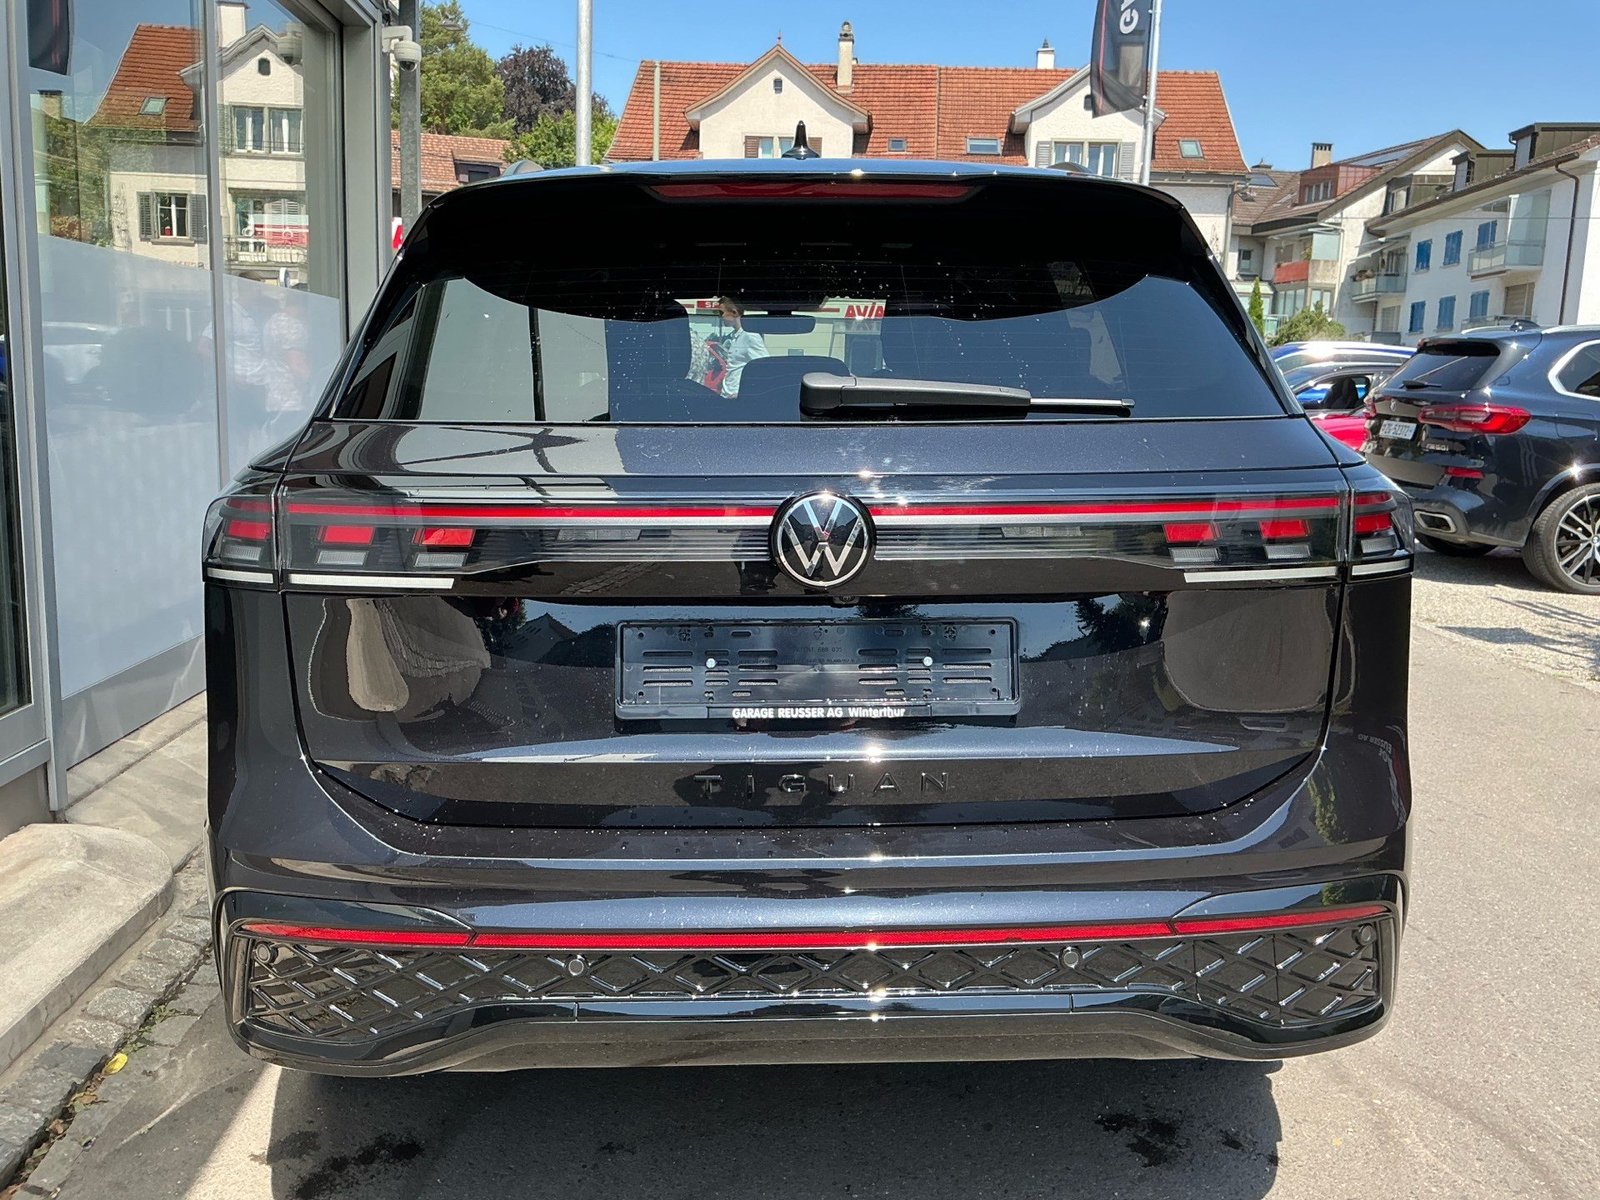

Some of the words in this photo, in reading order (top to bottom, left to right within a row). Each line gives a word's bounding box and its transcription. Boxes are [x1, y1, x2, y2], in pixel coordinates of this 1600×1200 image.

[844, 304, 884, 318] AVIA
[732, 708, 774, 718] GARAGE
[777, 708, 824, 718] REUSSER
[827, 708, 843, 718] AG
[848, 706, 906, 718] Winterthur
[694, 774, 949, 794] TIGUAN
